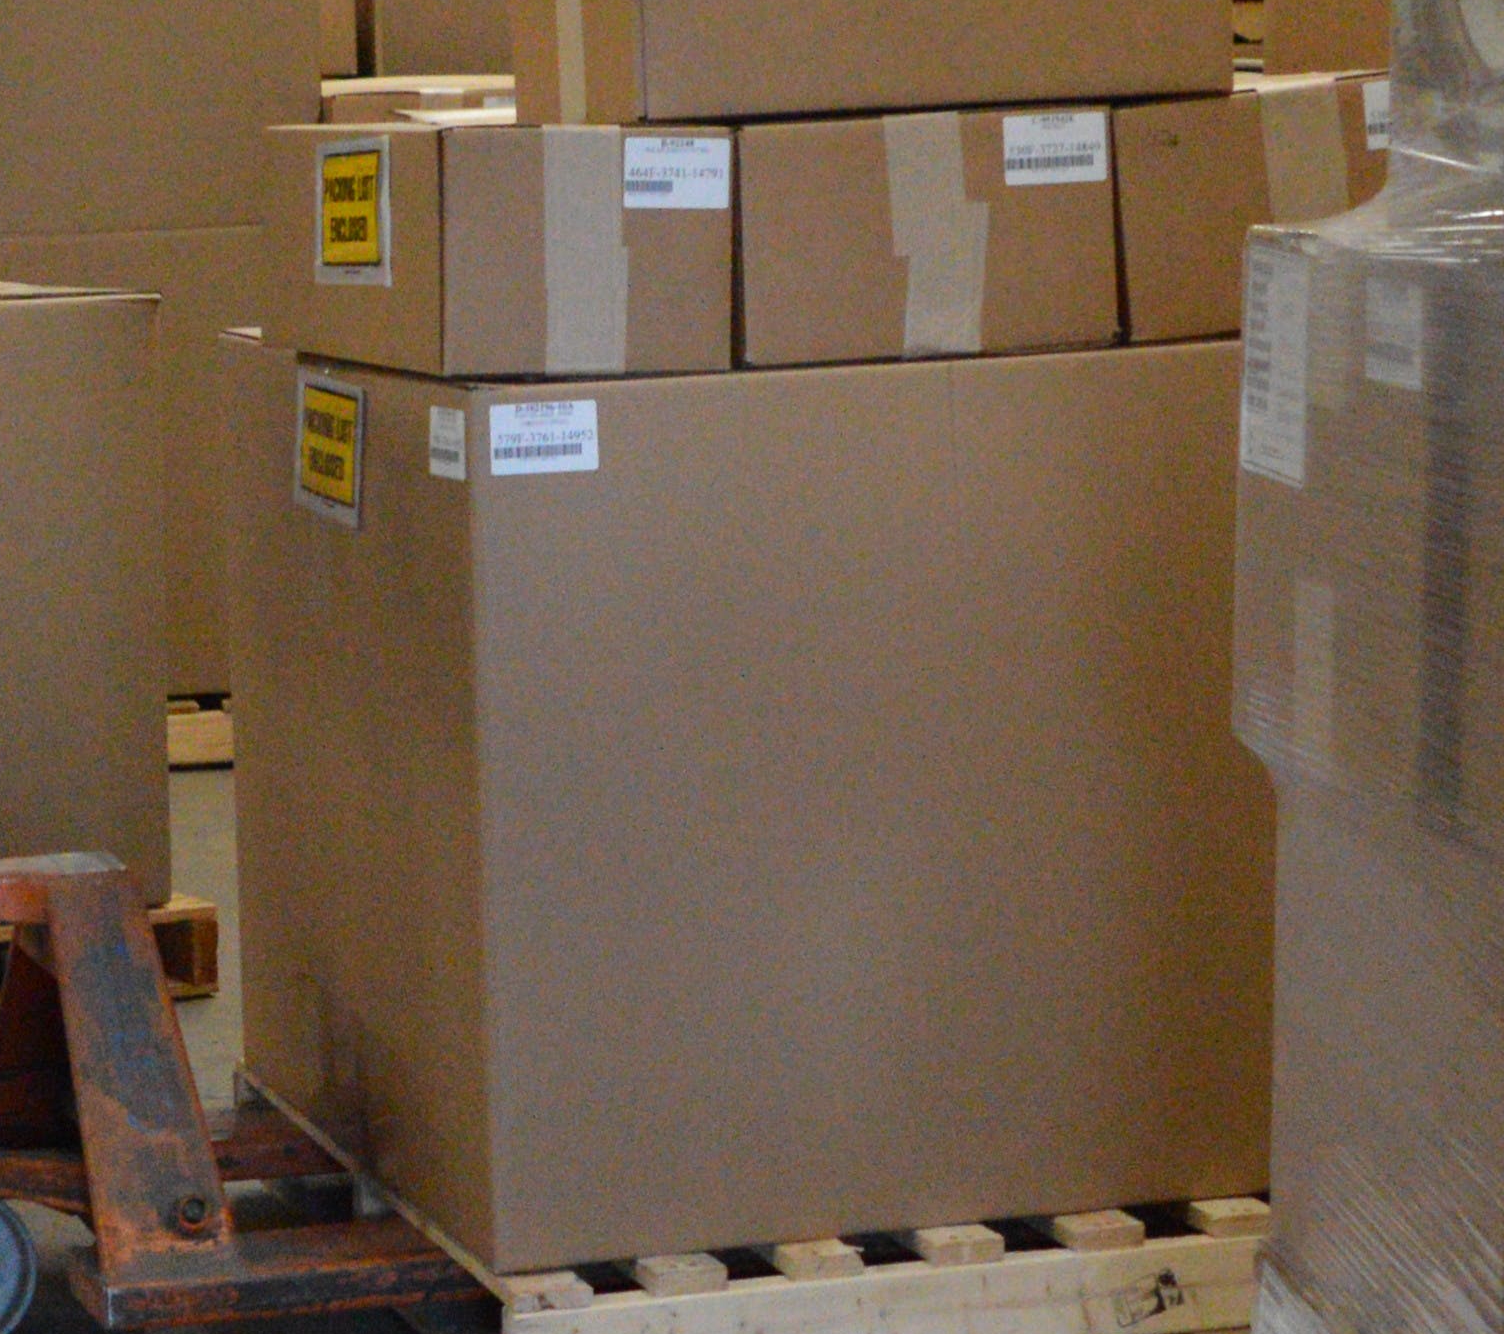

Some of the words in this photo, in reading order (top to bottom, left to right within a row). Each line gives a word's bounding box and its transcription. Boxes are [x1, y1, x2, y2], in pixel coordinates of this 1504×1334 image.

[323, 176, 356, 202] PACKING
[357, 174, 374, 201] LIST
[330, 217, 368, 243] ENCLOSED
